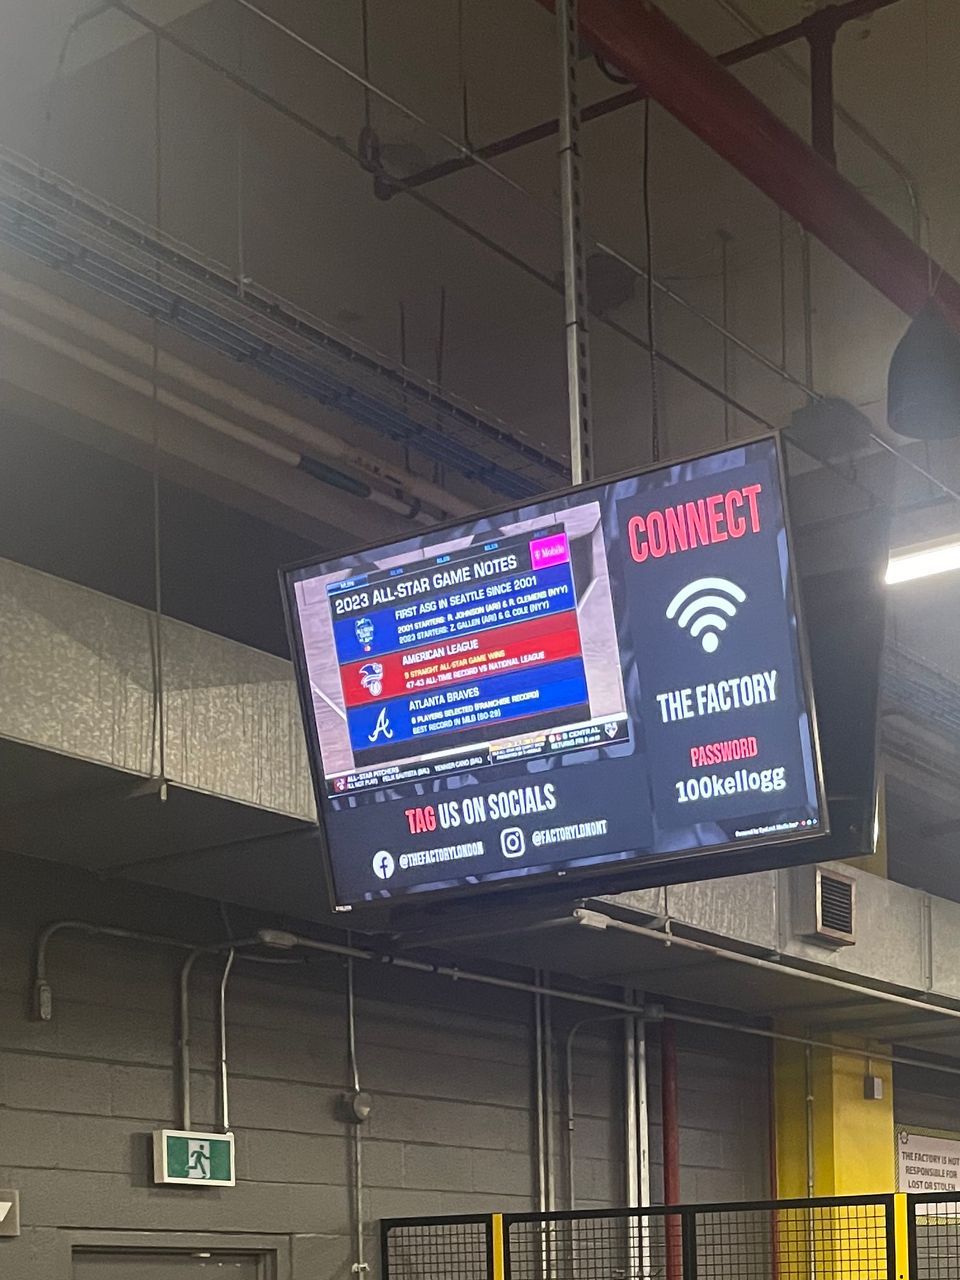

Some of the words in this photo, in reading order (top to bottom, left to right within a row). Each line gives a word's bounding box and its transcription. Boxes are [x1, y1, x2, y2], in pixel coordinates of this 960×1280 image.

[627, 484, 761, 563] CONNECT
[336, 595, 369, 614] 2023
[373, 578, 430, 605] ALL-STAR
[433, 567, 471, 588] GAME
[474, 554, 517, 578] NOTES
[395, 606, 417, 620] FIRST
[419, 601, 437, 614] ASG
[438, 598, 448, 609] IN
[449, 589, 485, 606] SEATTLE
[486, 582, 512, 597] SINCE
[513, 575, 537, 591] 2001
[397, 623, 413, 634] 2001
[455, 606, 485, 619] JOHNSON
[516, 591, 547, 604] CLEMENS
[456, 617, 480, 630] GALLEN
[512, 606, 528, 616] COLE
[402, 646, 445, 666] AMERICAN
[446, 639, 479, 655] LEAGUE
[410, 665, 439, 678] STRAIGHT
[440, 658, 468, 672] ALL-STAR
[469, 653, 487, 665] GAME
[487, 649, 505, 660] WINS
[426, 672, 453, 685] ALL-TIME
[453, 666, 479, 679] RECORD
[479, 664, 488, 673] VS
[488, 657, 520, 670] NATIONAL
[520, 651, 545, 664] LEAGUE
[409, 694, 445, 711] ATLANTA
[446, 686, 480, 703] BRAVES
[657, 688, 694, 723] THE
[696, 670, 777, 716] FACTORY
[412, 724, 428, 735] BEST
[428, 719, 453, 732] RECORD
[453, 717, 461, 726] IN
[416, 711, 443, 723] PLAYERS
[444, 704, 474, 717] SELECTED
[690, 736, 758, 767] PASSWORD
[676, 766, 786, 803] 100kellogg
[405, 806, 437, 834] TAG
[438, 801, 461, 829] US
[463, 796, 487, 824] ON
[489, 783, 556, 819] SOCIALS
[902, 1151, 914, 1161] THE
[914, 1153, 941, 1165] FACTORY
[941, 1155, 947, 1165] IS
[948, 1156, 960, 1166] NOT
[905, 1166, 945, 1177] RESPONSIBLE
[946, 1169, 957, 1179] FOR
[908, 1180, 923, 1189] LOST
[924, 1181, 933, 1190] OR
[934, 1182, 956, 1192] STOLEN
